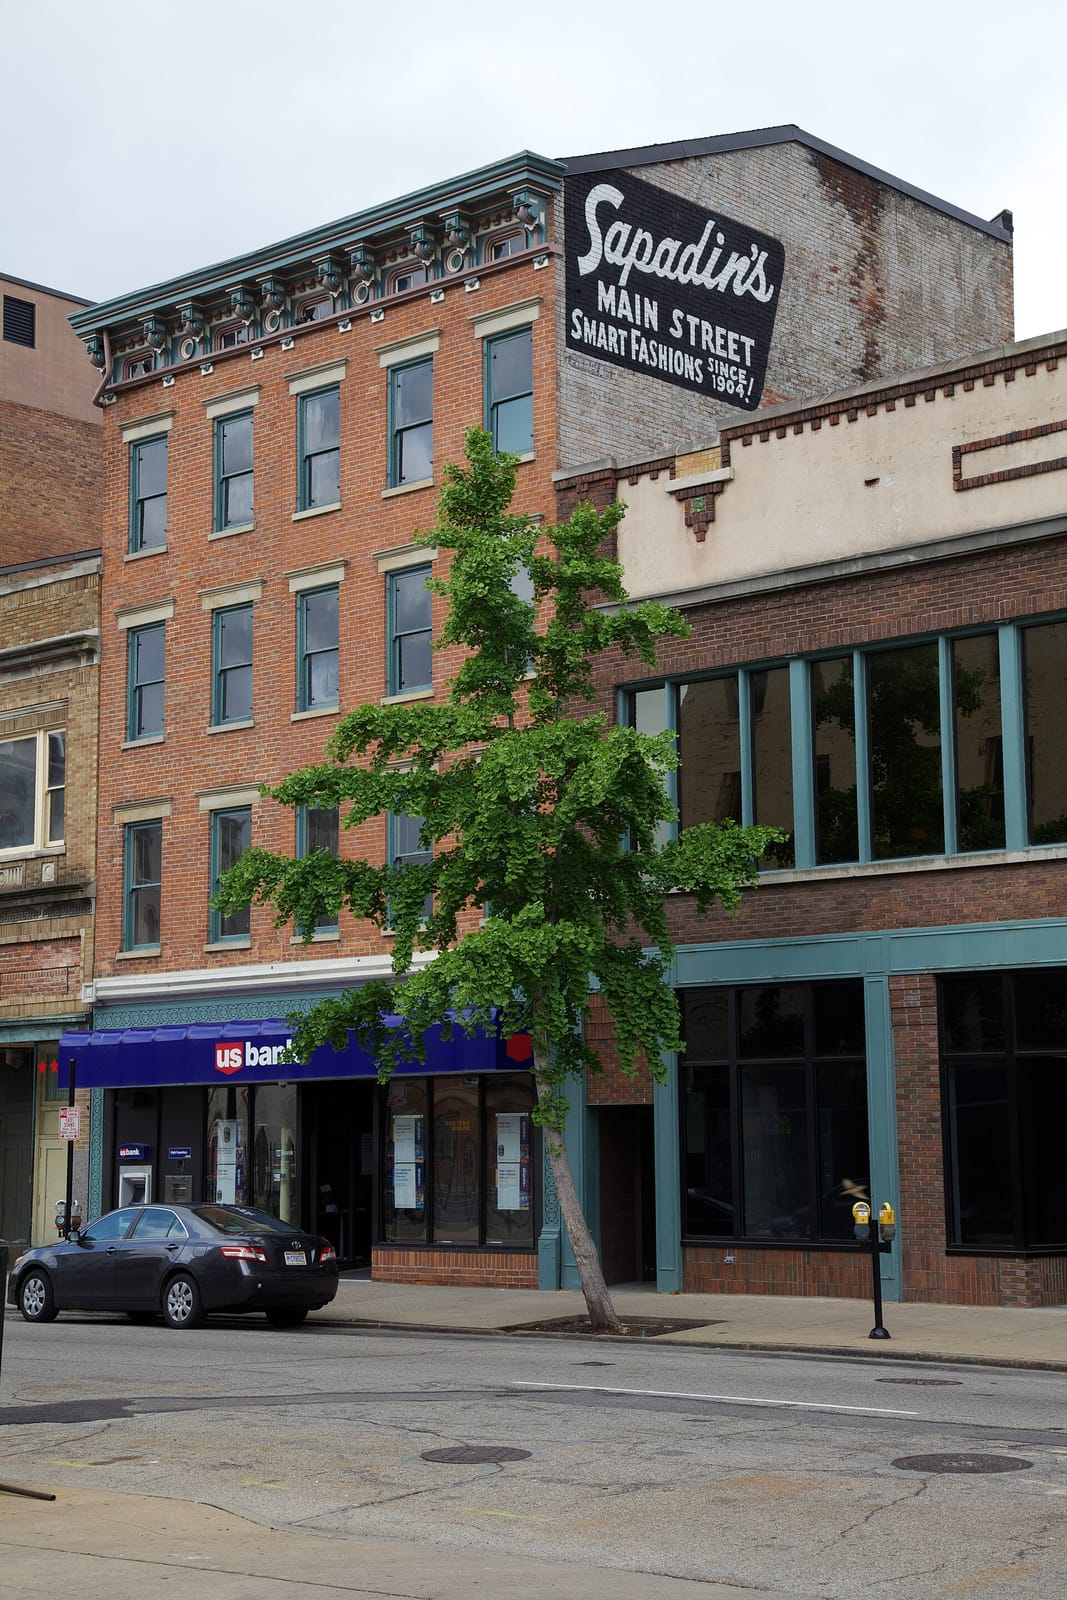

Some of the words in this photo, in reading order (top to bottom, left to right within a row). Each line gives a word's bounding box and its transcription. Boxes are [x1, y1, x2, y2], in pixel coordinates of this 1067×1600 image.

[577, 183, 775, 303] Sapadin's
[571, 308, 628, 357] SMART
[630, 328, 704, 384] FASHIONS
[597, 279, 659, 332] MAIN
[668, 308, 755, 367] STREET
[707, 357, 747, 385] SINCE
